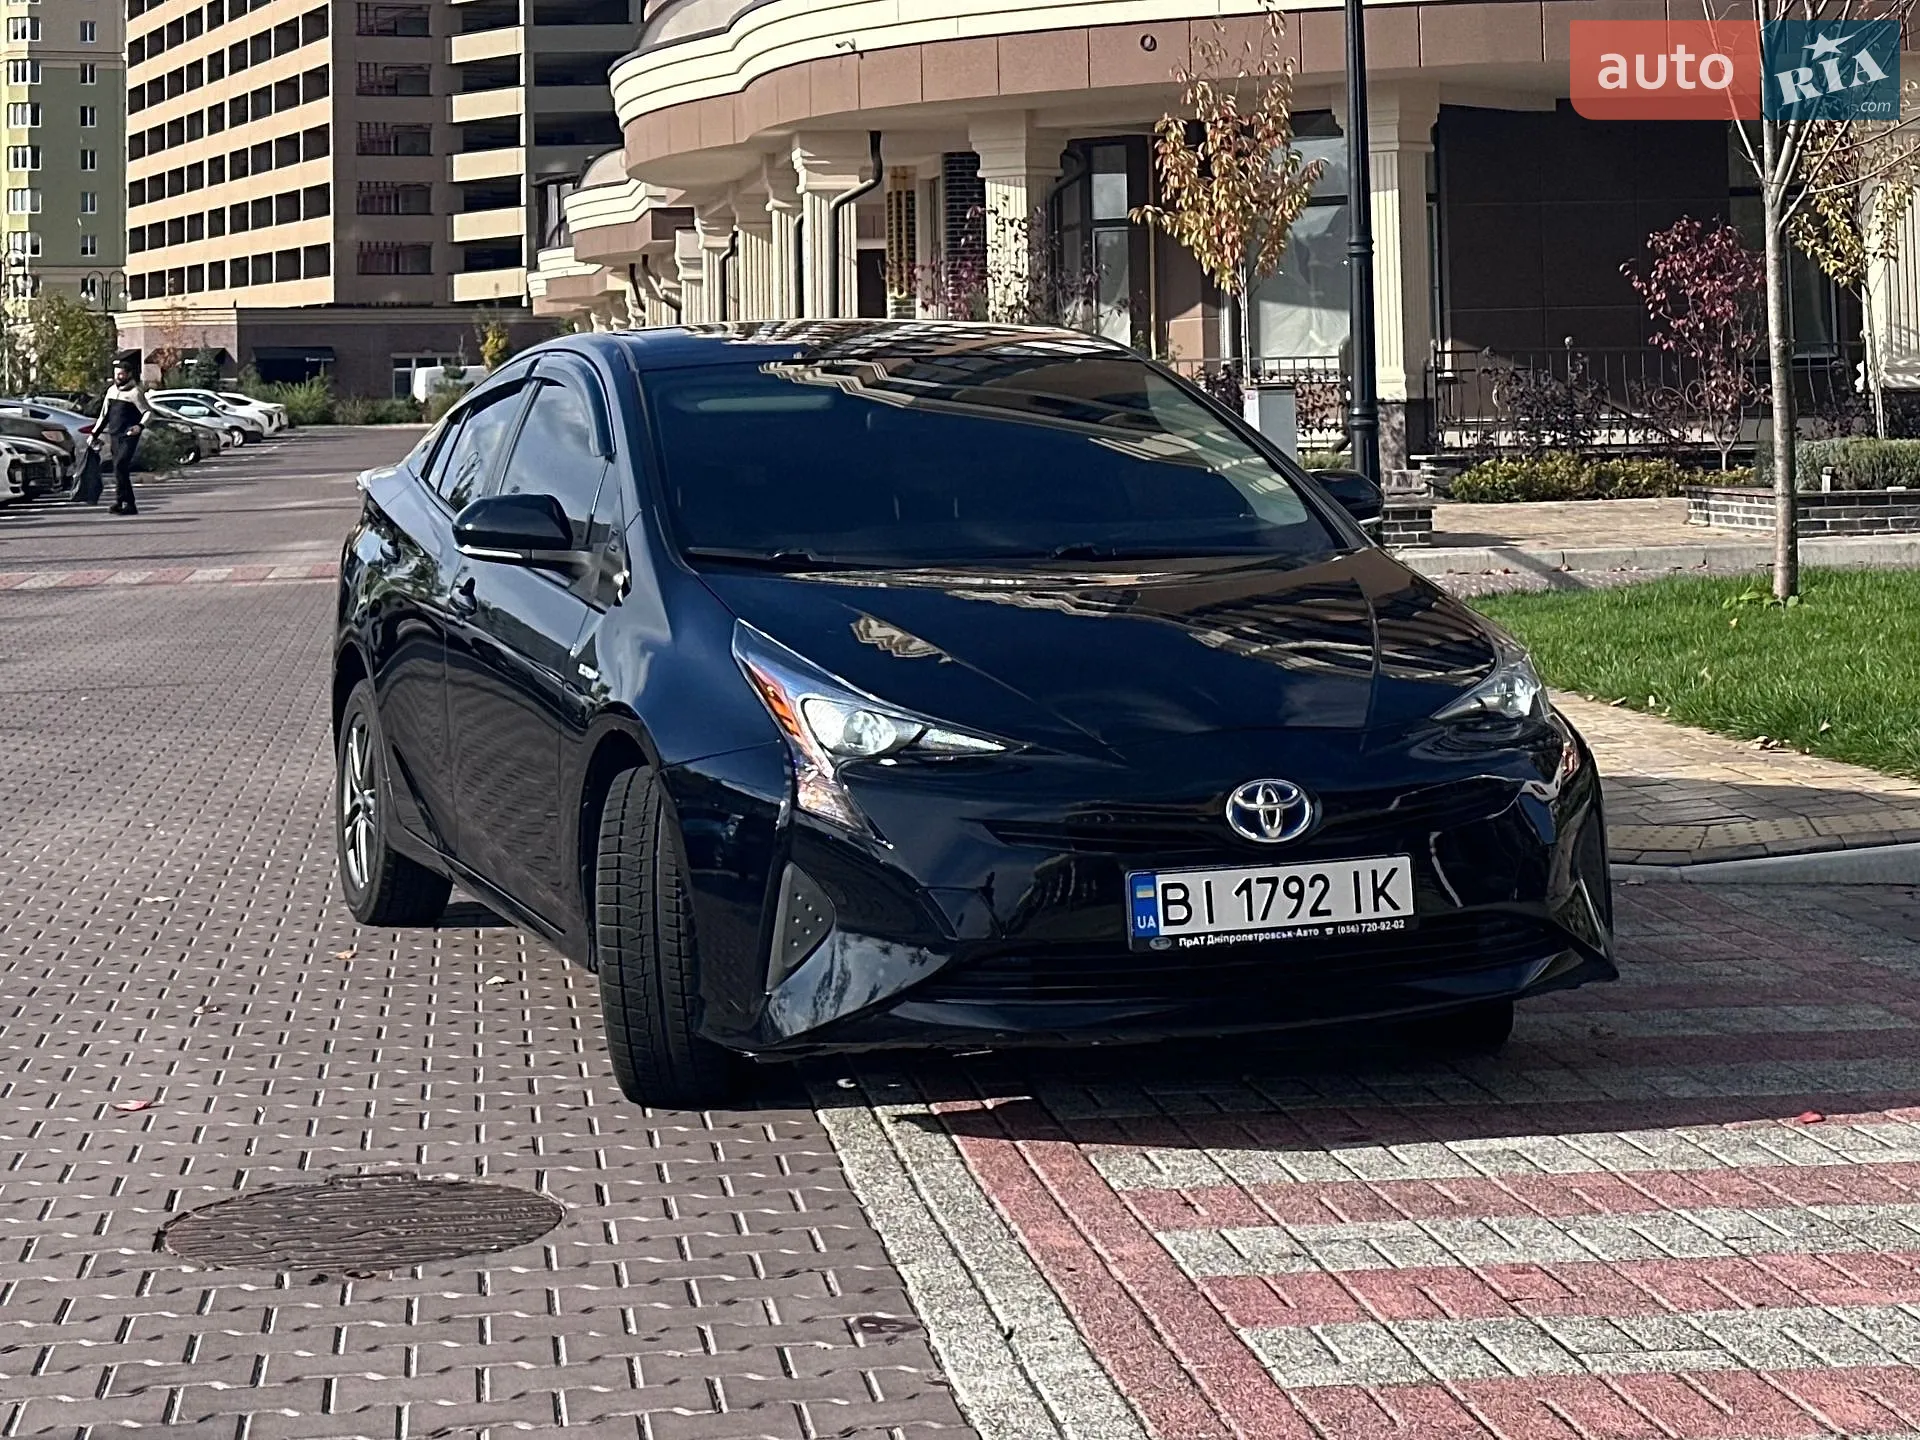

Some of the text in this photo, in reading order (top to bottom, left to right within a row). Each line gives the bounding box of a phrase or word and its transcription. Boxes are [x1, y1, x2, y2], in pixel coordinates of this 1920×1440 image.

[1160, 867, 1401, 927] BI 1792 IK
[1137, 915, 1157, 929] UA
[1179, 935, 1206, 948] ПрАТ
